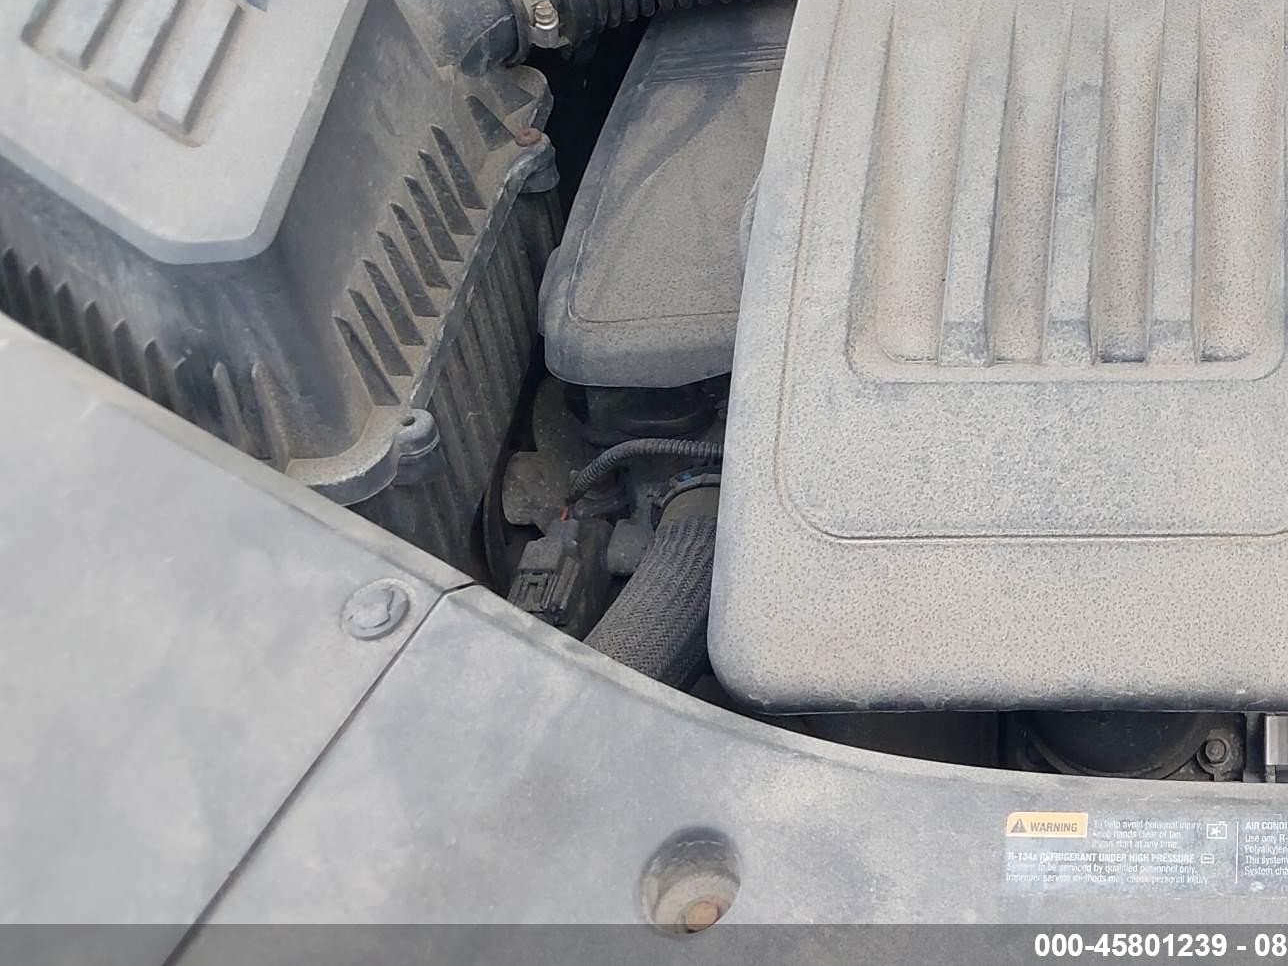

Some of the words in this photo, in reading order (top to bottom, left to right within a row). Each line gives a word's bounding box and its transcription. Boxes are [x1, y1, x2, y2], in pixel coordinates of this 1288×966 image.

[1030, 822, 1078, 833] WARNING
[1123, 820, 1144, 829] avoid
[1244, 821, 1260, 831] AIR
[1114, 830, 1137, 839] hands
[1159, 831, 1167, 839] of
[1040, 852, 1097, 862] REFRIGERANT
[1099, 853, 1126, 862] UNDER
[1129, 853, 1149, 863] HIGH
[1151, 854, 1195, 863] PRESSURE
[1261, 856, 1288, 866] system
[1094, 863, 1104, 875] by
[1244, 866, 1273, 877] System
